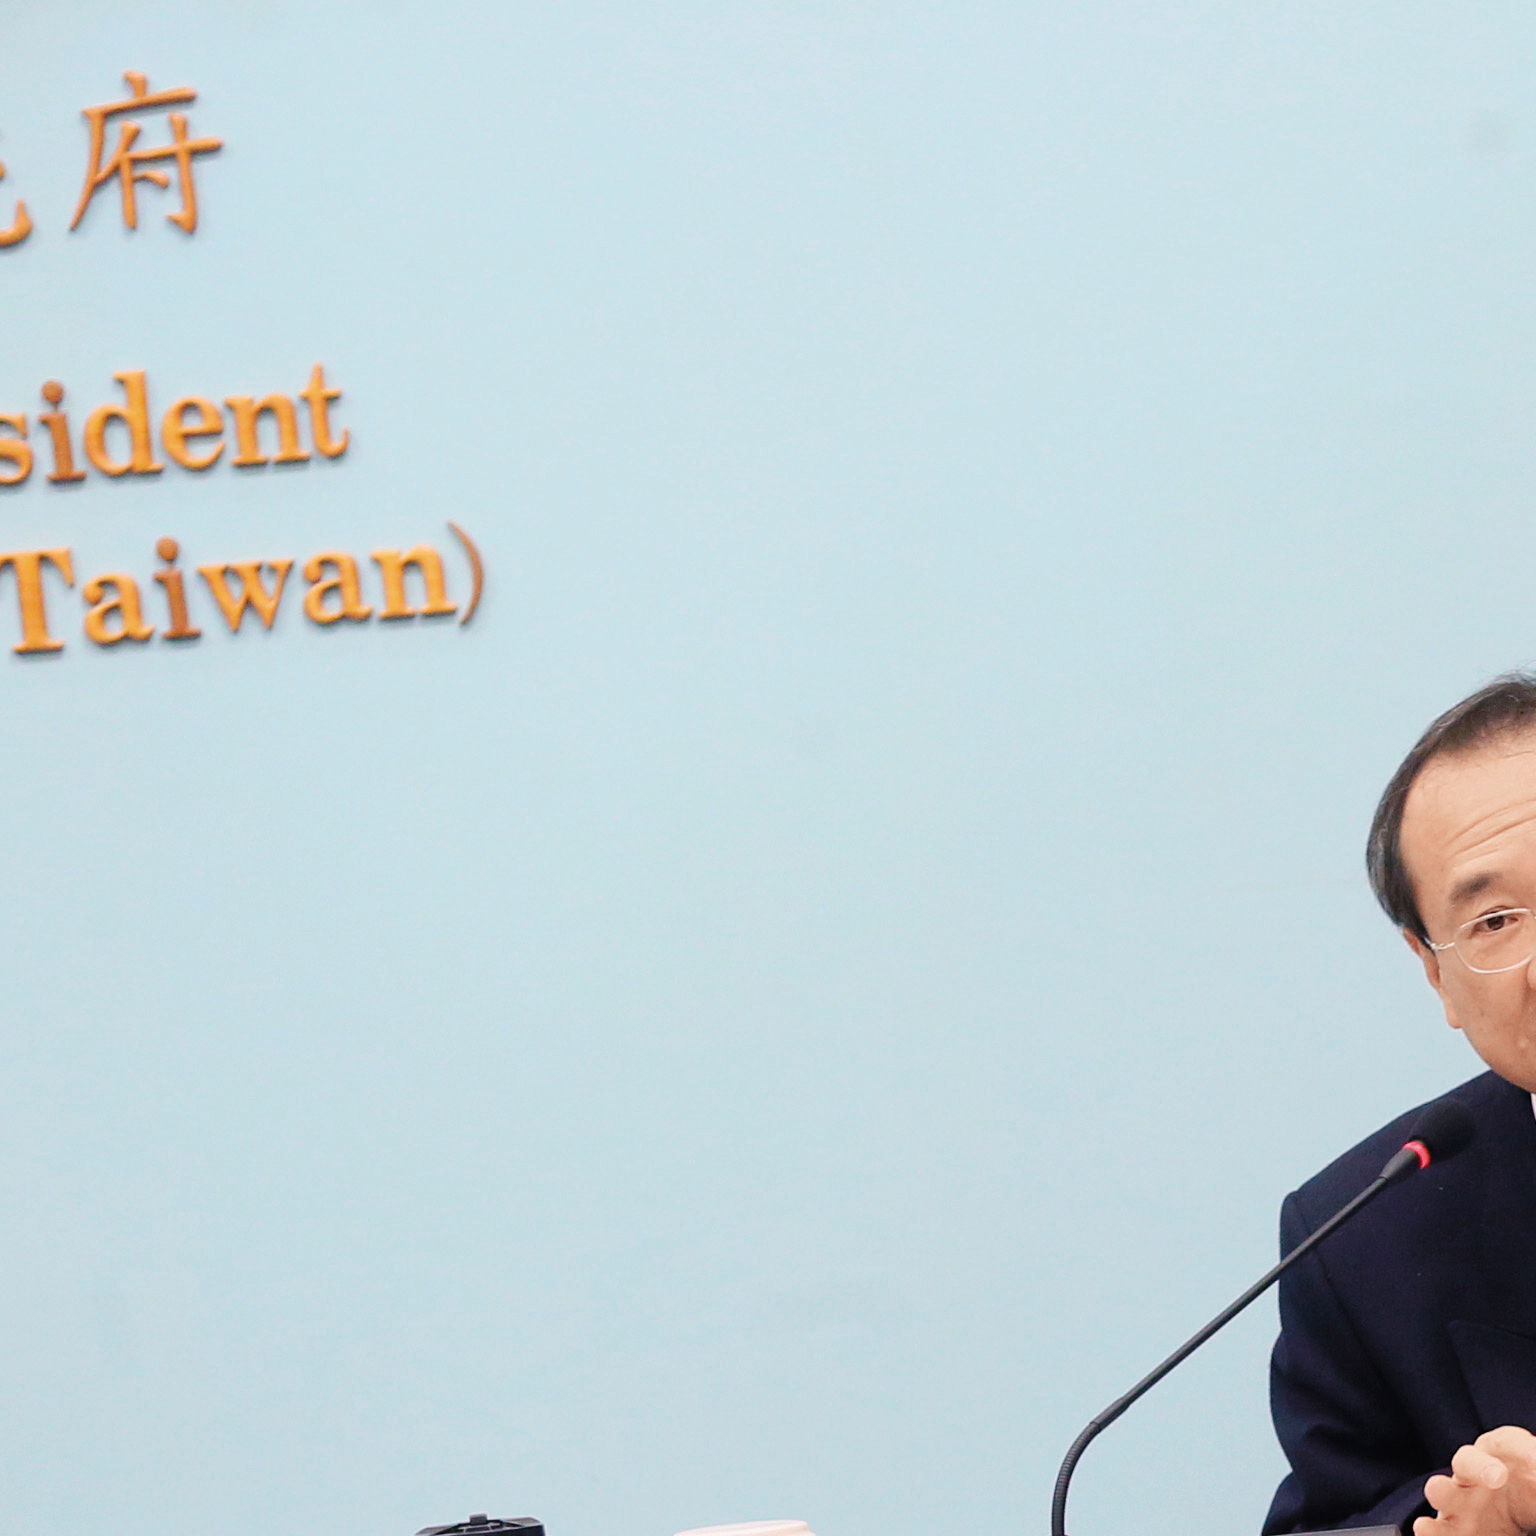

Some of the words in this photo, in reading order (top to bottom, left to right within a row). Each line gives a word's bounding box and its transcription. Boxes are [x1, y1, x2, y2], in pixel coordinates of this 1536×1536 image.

[0, 70, 224, 246] 府
[0, 362, 349, 486] sident
[0, 519, 484, 655] Taiwan)
